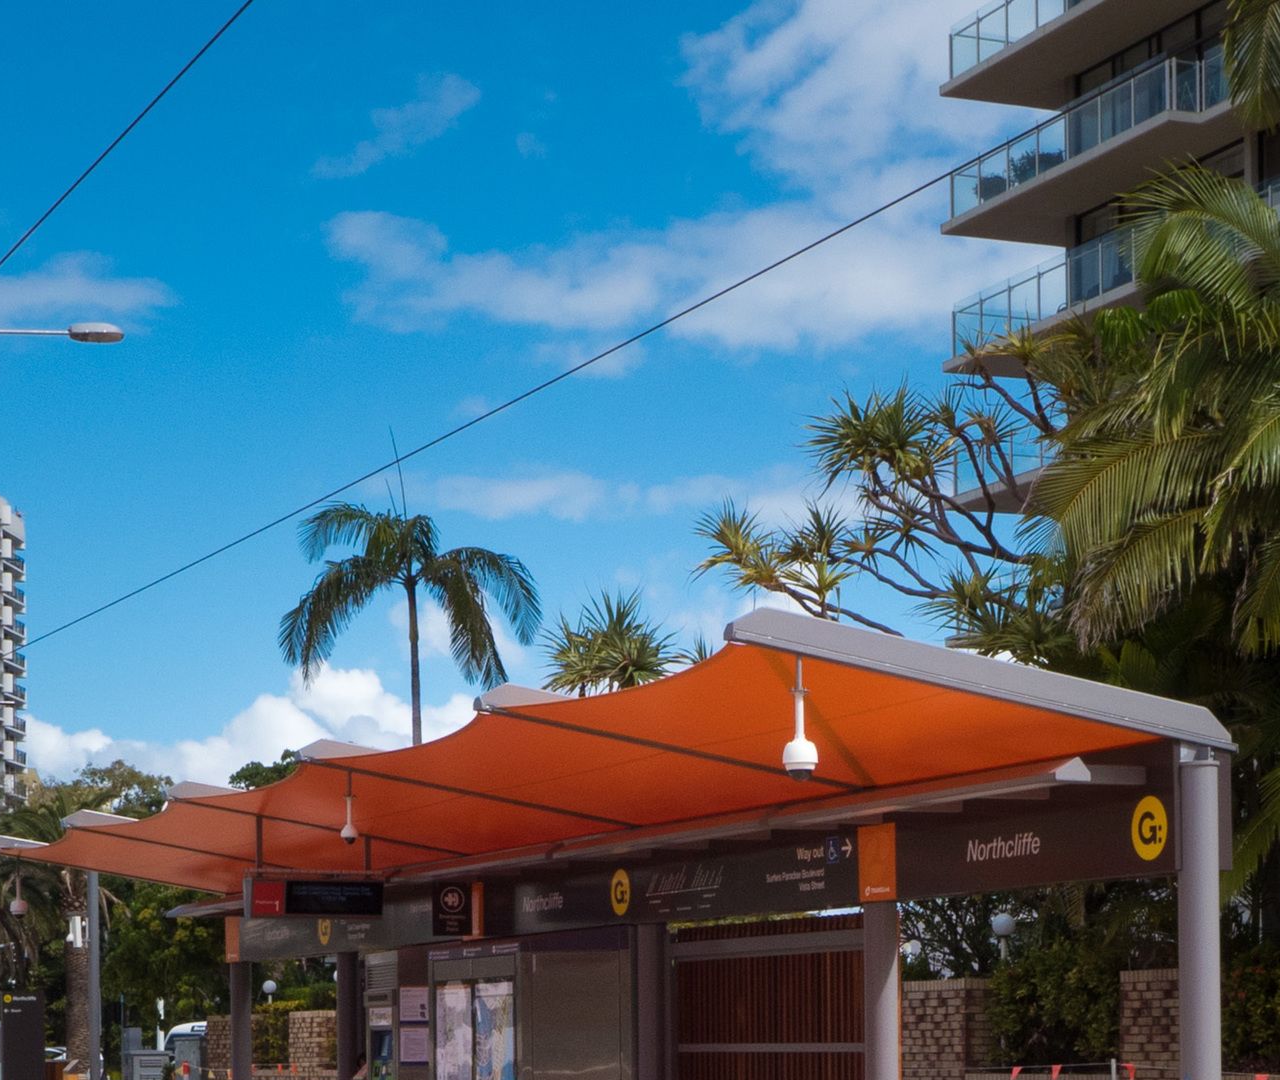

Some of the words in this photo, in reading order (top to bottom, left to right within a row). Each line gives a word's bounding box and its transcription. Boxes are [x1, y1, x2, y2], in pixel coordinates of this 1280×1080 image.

[796, 847, 813, 862] Way
[813, 846, 825, 859] out
[966, 831, 1041, 863] Northcliffe
[274, 900, 280, 912] 1
[522, 892, 564, 913] Northcliffe
